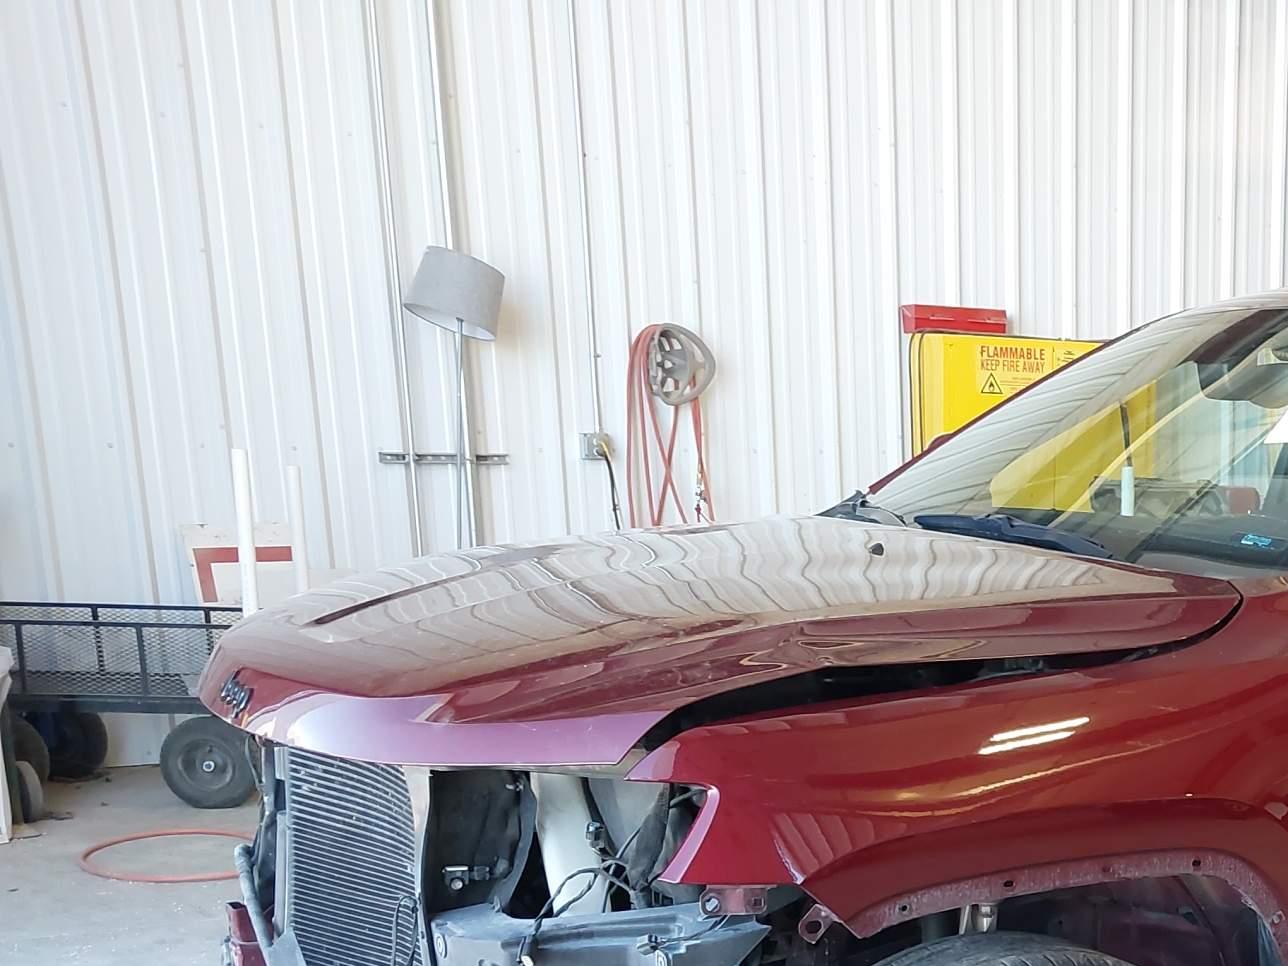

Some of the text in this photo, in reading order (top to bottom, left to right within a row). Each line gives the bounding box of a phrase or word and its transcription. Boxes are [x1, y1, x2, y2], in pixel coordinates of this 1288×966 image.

[980, 345, 1046, 361] FLAMMABLE
[980, 359, 1046, 374] KEEP FIRE AWAY
